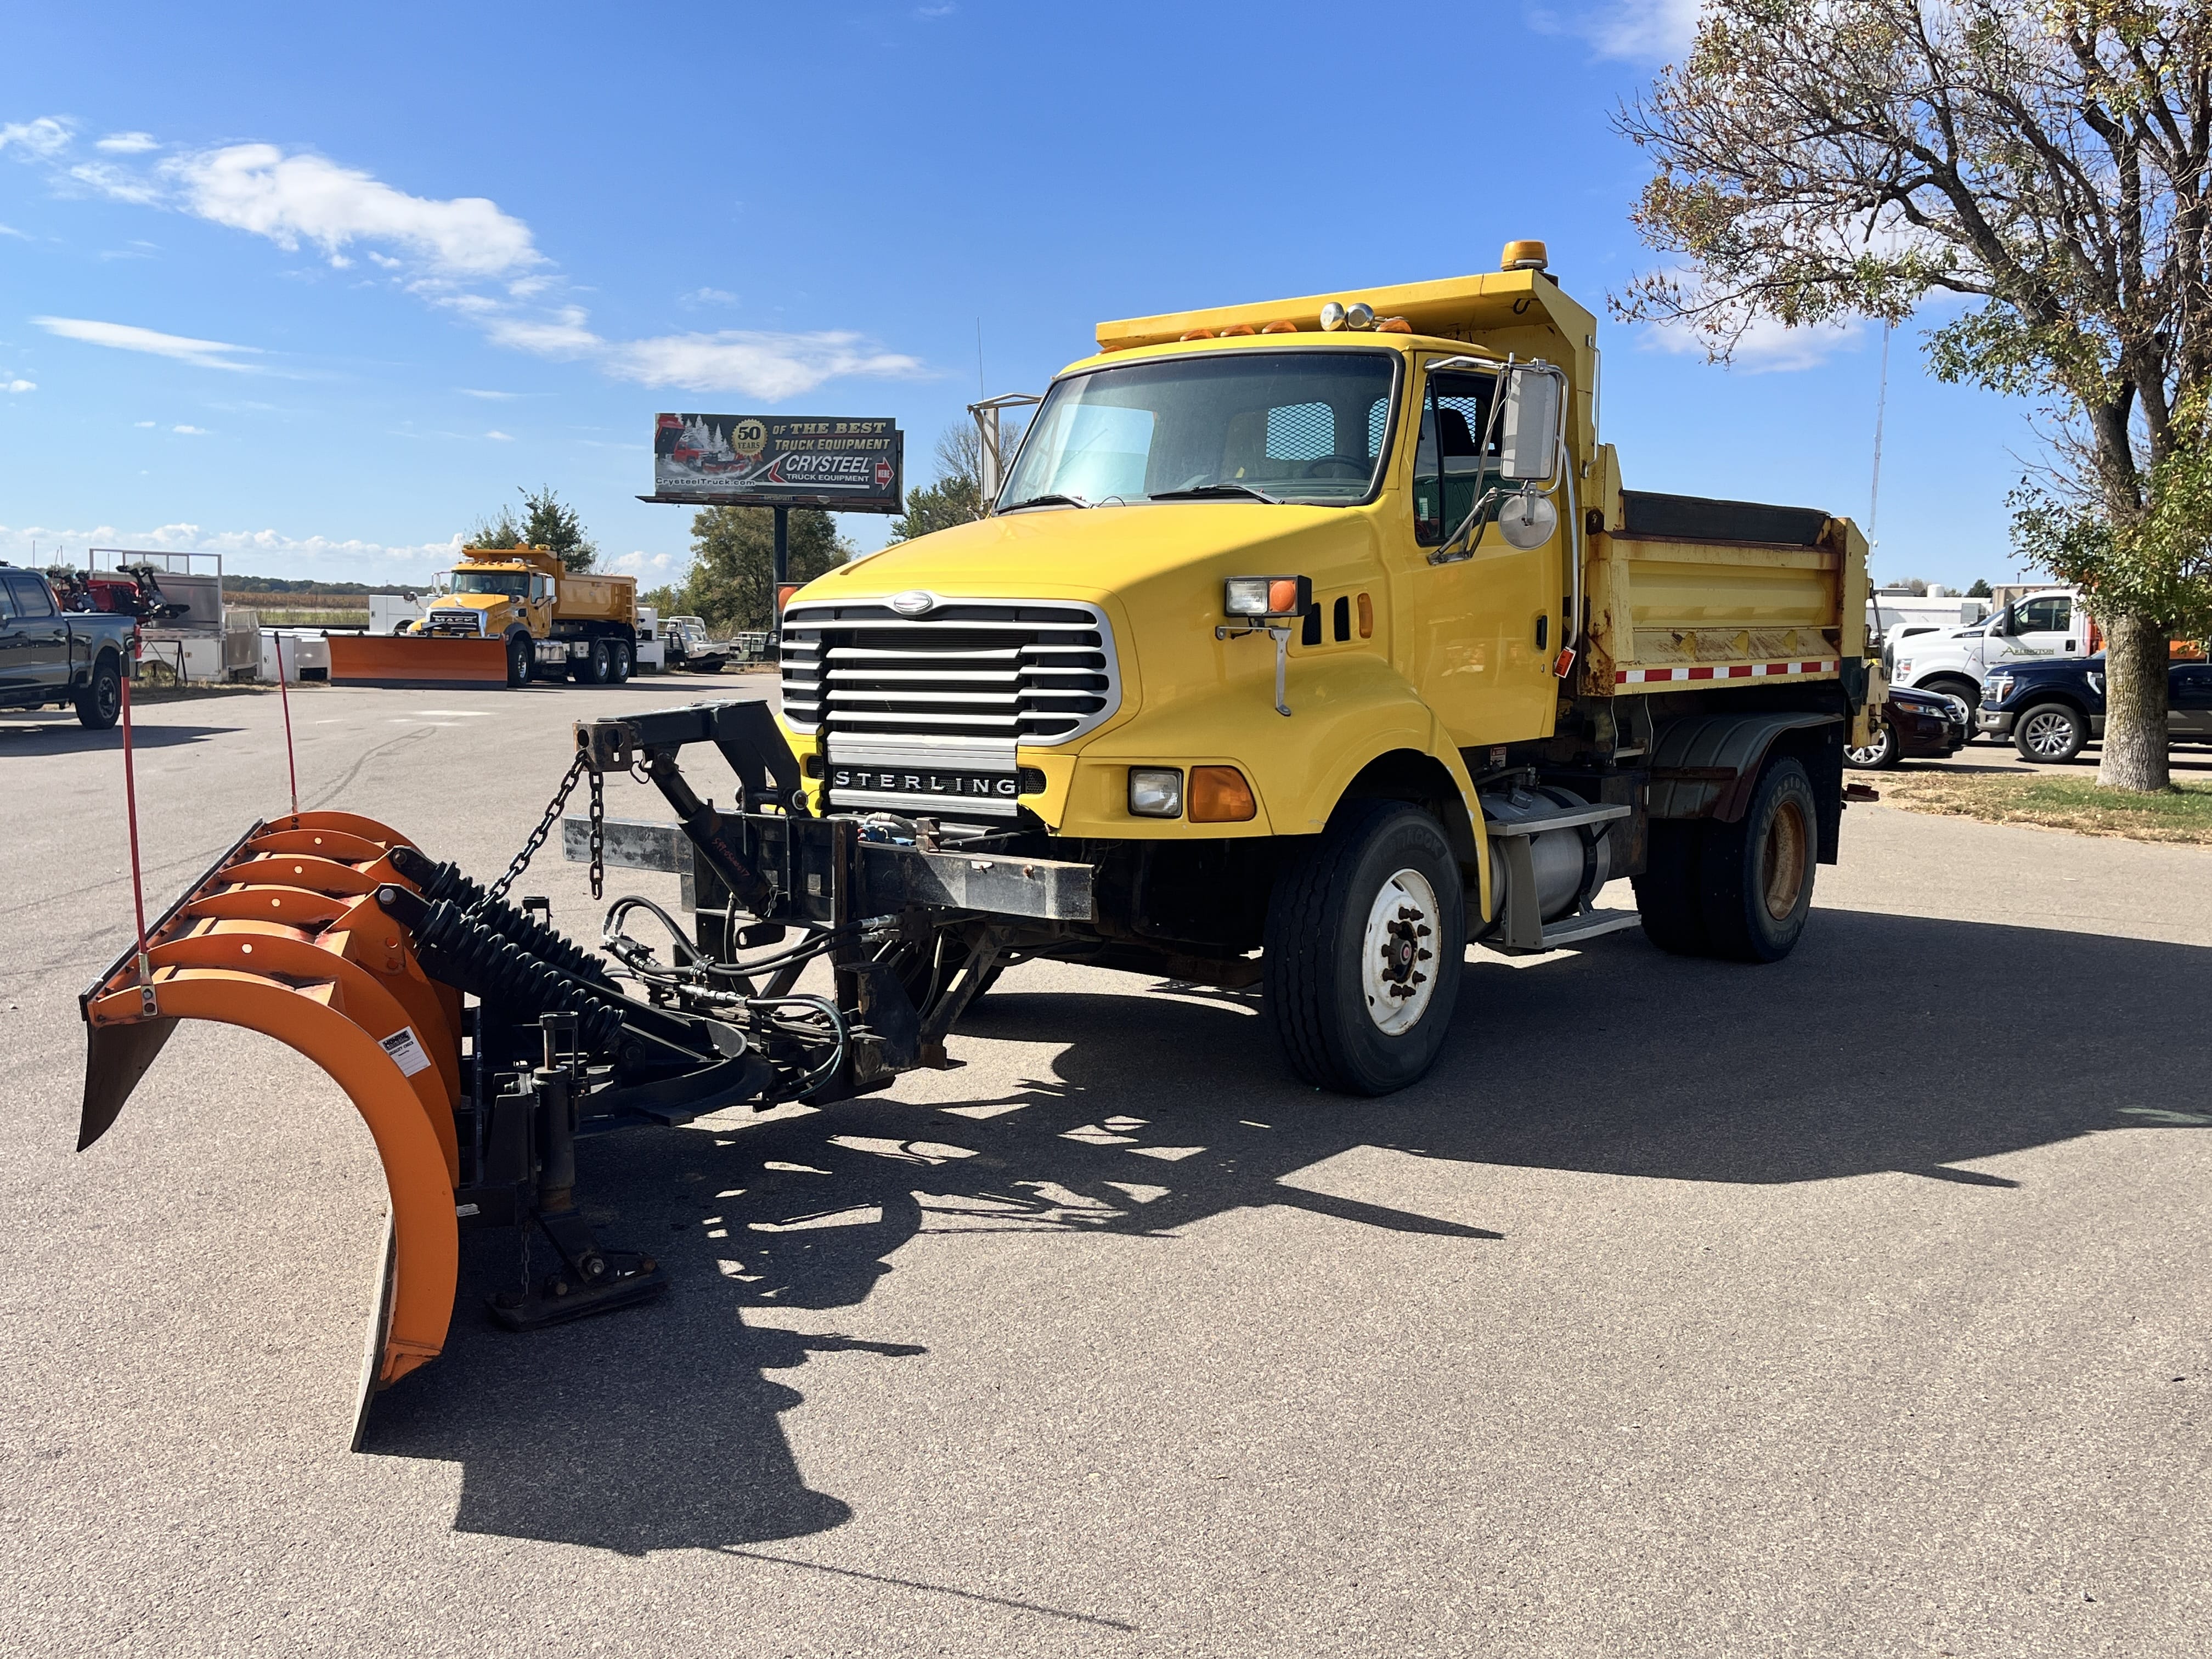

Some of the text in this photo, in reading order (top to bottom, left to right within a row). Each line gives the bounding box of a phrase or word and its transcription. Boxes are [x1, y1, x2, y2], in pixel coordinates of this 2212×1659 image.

[738, 426, 761, 440] 50
[772, 422, 886, 435] OF THE BEST
[775, 439, 890, 451] TRUCK EQUIPMENT
[786, 455, 870, 473] CRYSTEEL
[878, 470, 890, 478] HERE
[656, 478, 755, 486] CrysteelTruck.com
[834, 771, 1017, 795] STERLING
